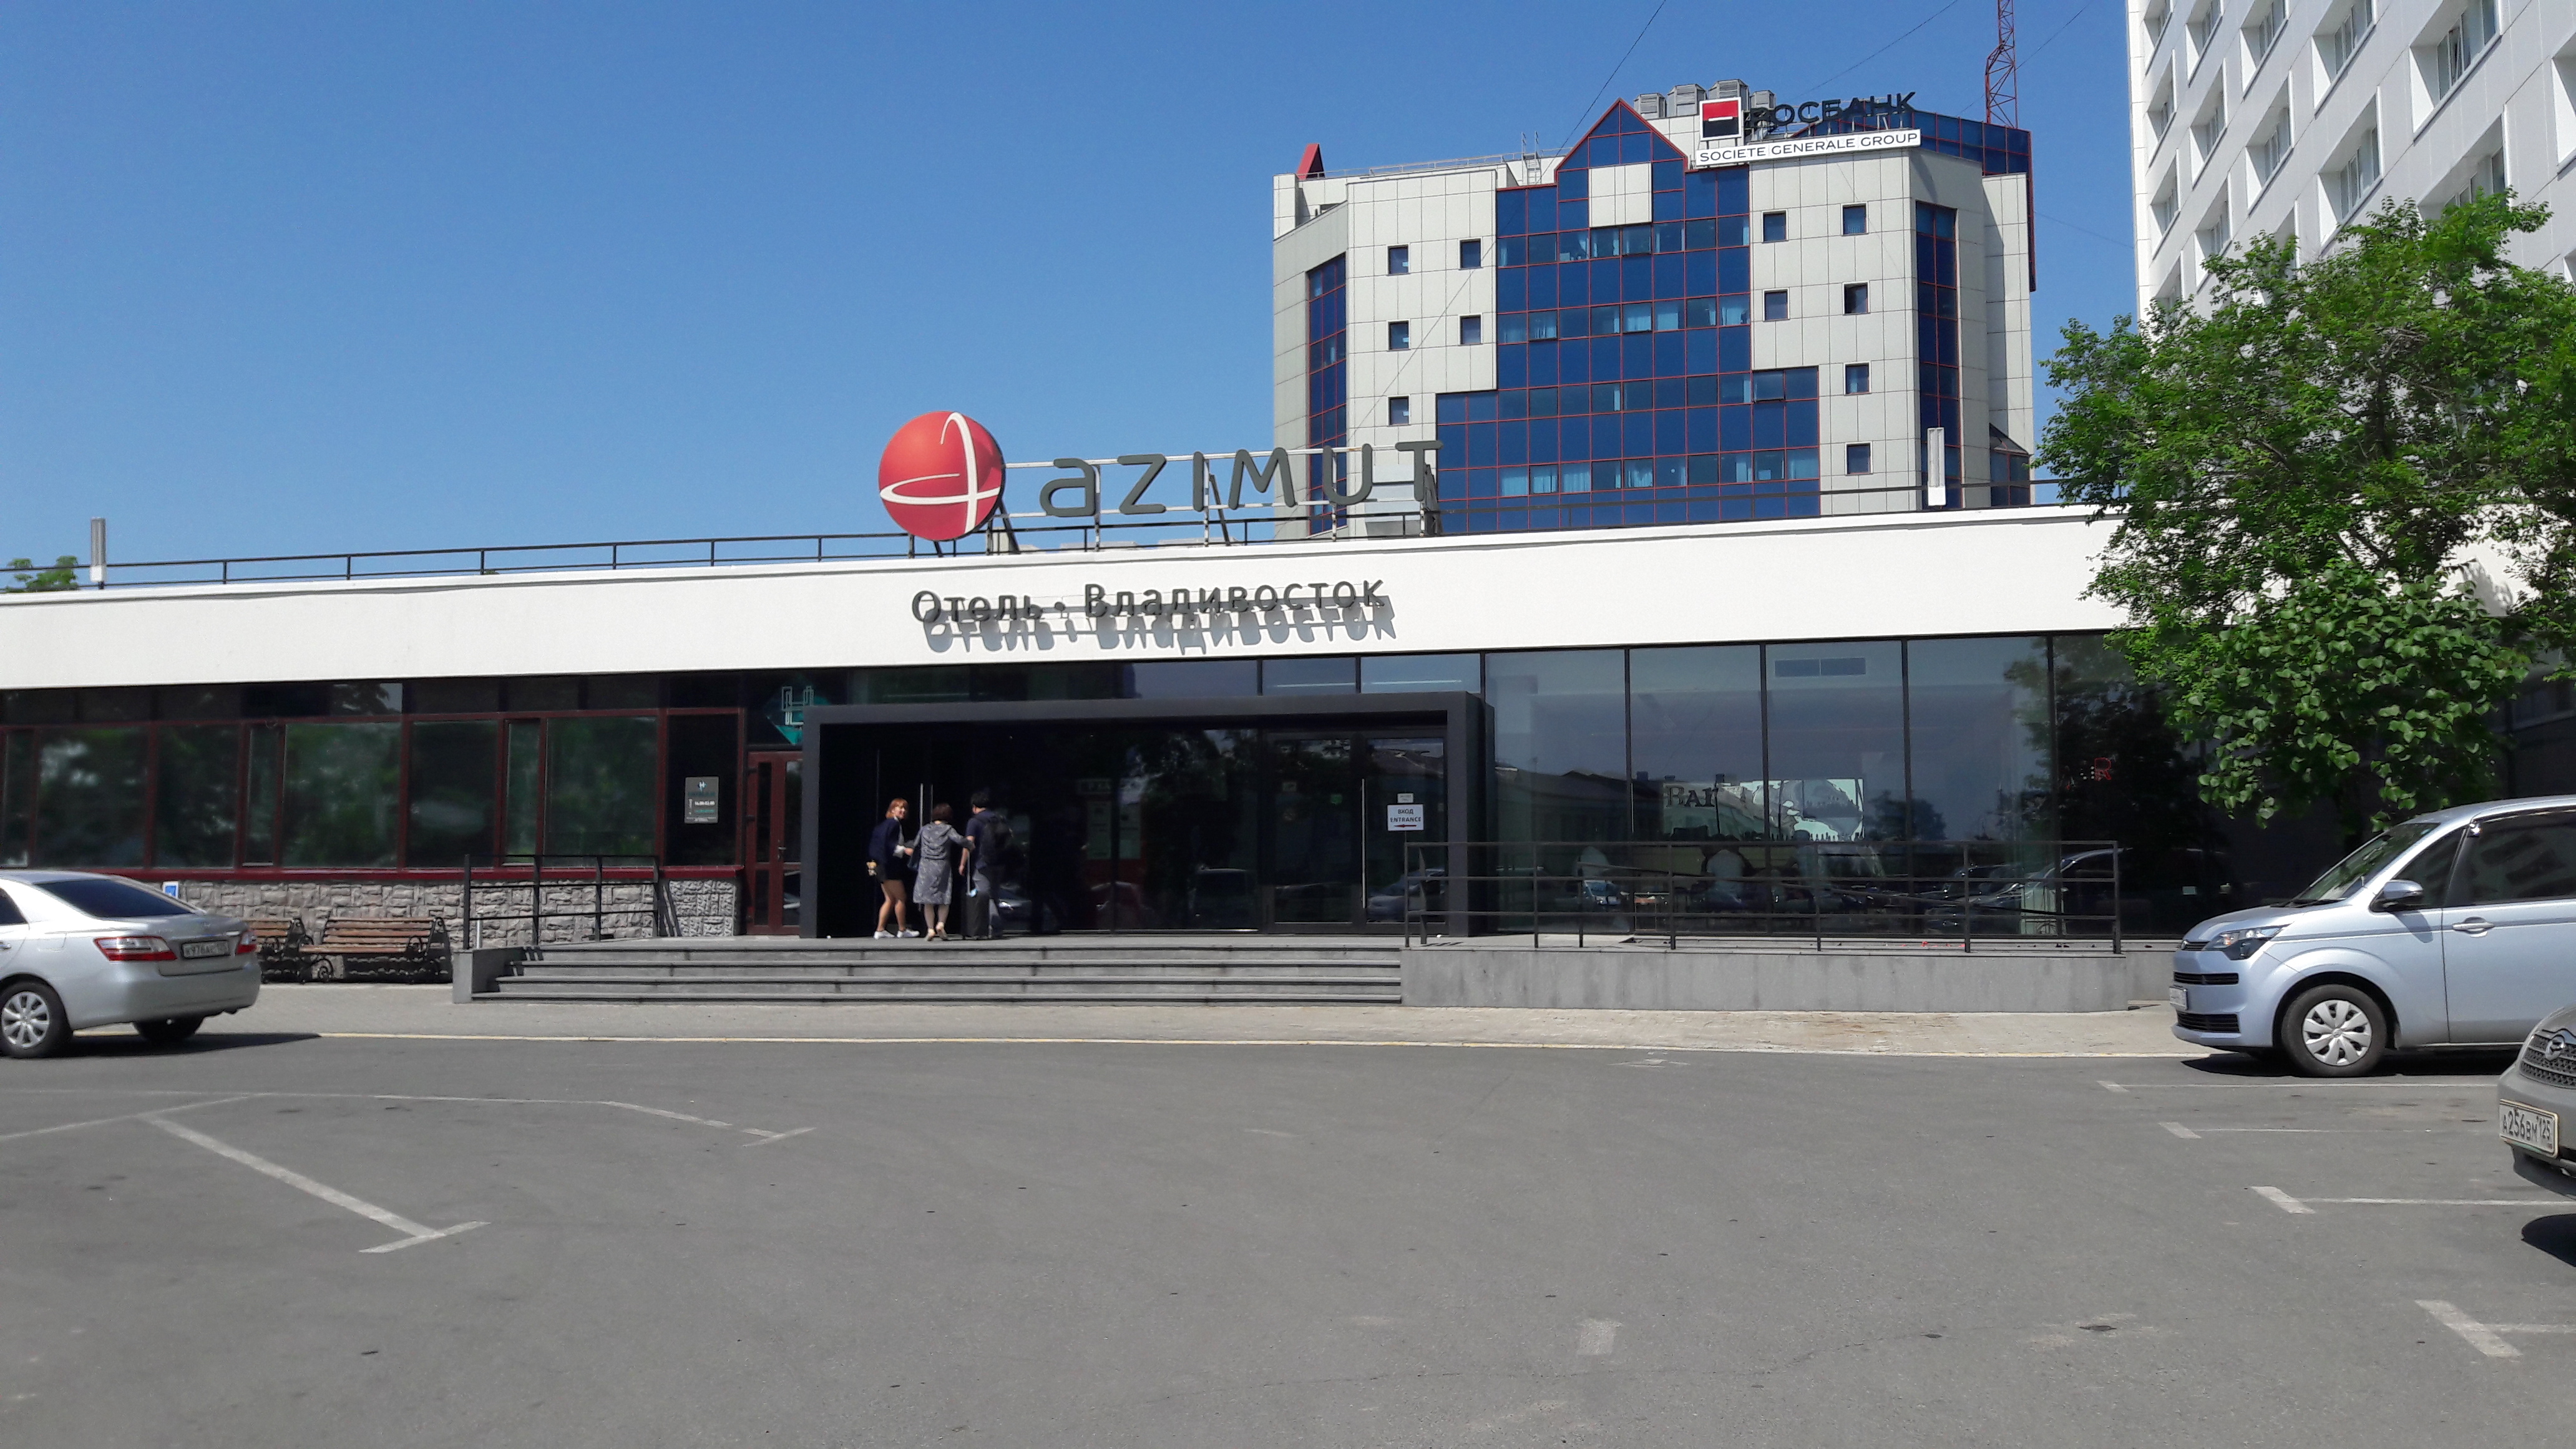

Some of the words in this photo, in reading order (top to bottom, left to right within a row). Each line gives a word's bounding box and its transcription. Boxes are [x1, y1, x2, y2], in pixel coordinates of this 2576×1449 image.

[1699, 146, 1767, 162] SOCIETE
[1771, 138, 1856, 155] GENERALE
[1860, 133, 1918, 147] GROUP
[912, 590, 1043, 623] Отель
[1085, 580, 1385, 618] Владивосток
